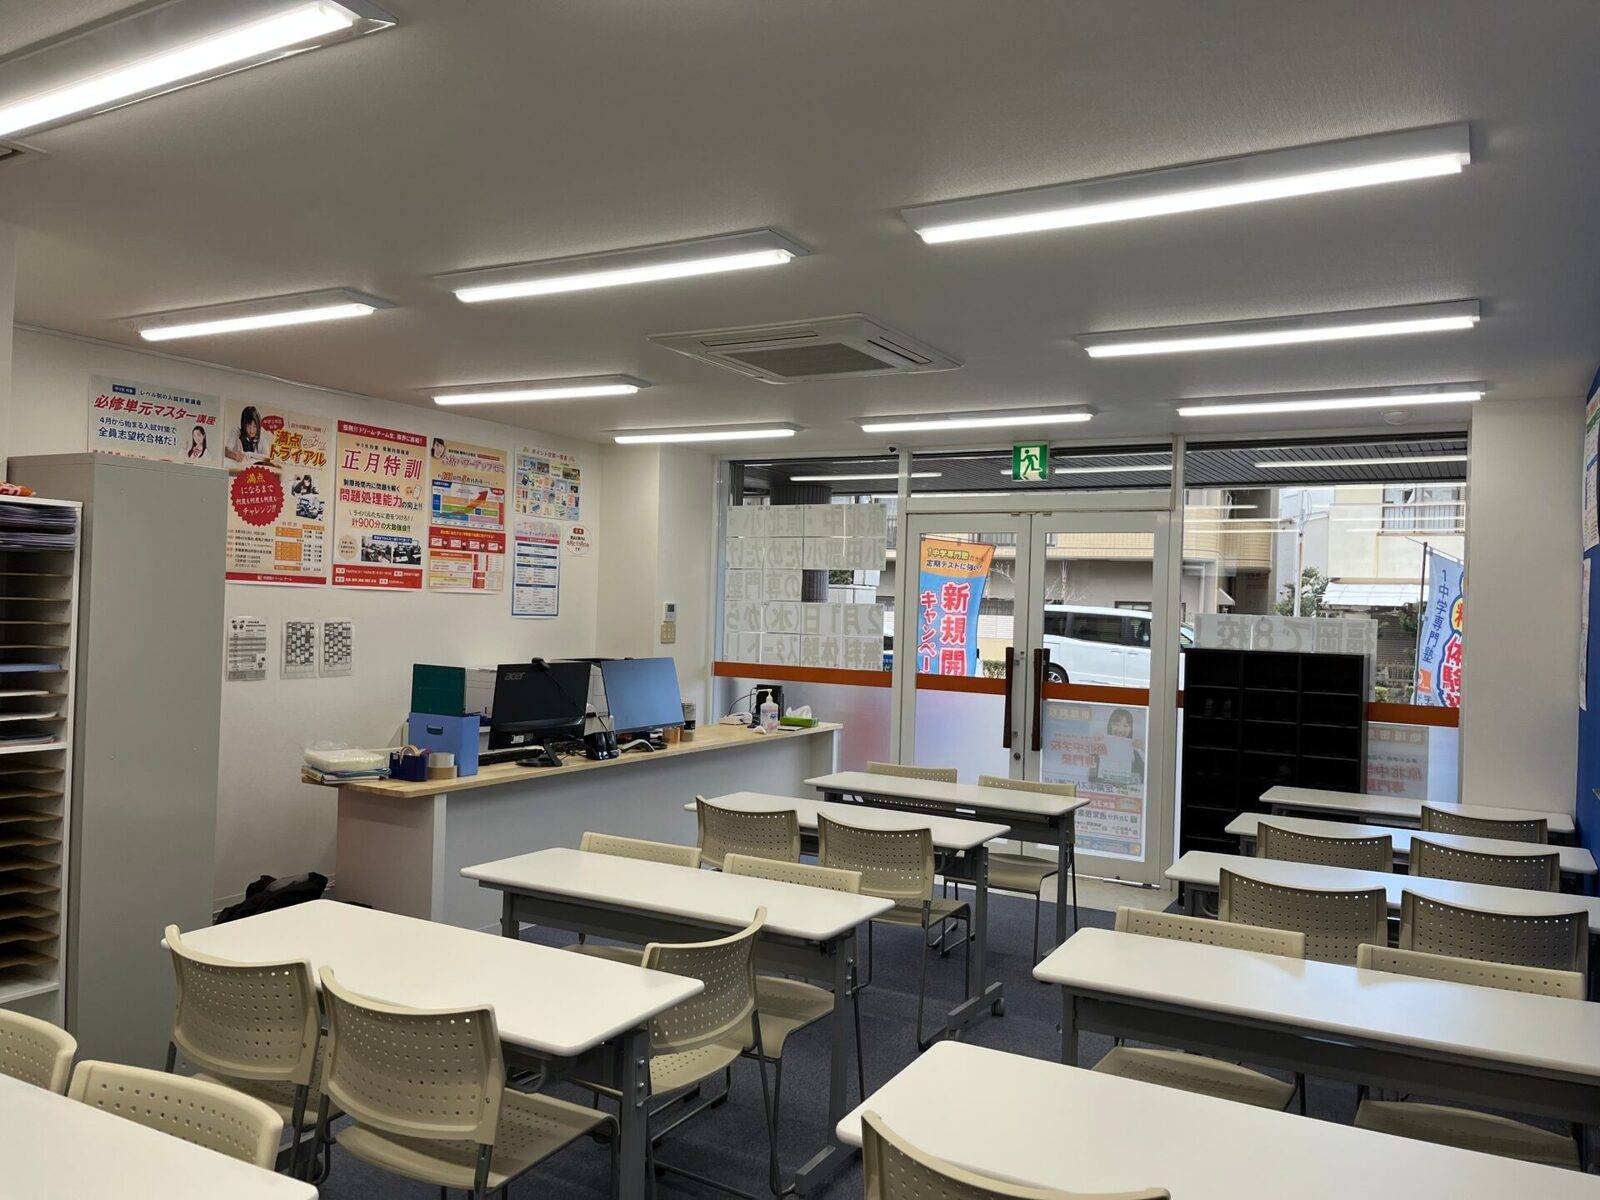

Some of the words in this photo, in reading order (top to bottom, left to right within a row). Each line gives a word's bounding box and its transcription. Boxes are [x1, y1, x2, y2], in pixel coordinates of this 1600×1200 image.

[94, 395, 217, 426] 必修単元マスター講座
[100, 417, 177, 434] 4月から始まる入試対策で
[275, 429, 303, 448] 満点
[269, 444, 327, 467] トライアル
[341, 449, 423, 480] 正月特訓
[240, 484, 275, 494] になるまで
[343, 478, 400, 492] 制限時間内に問題を解く
[941, 581, 970, 676] 新規開
[504, 671, 527, 681] acer
